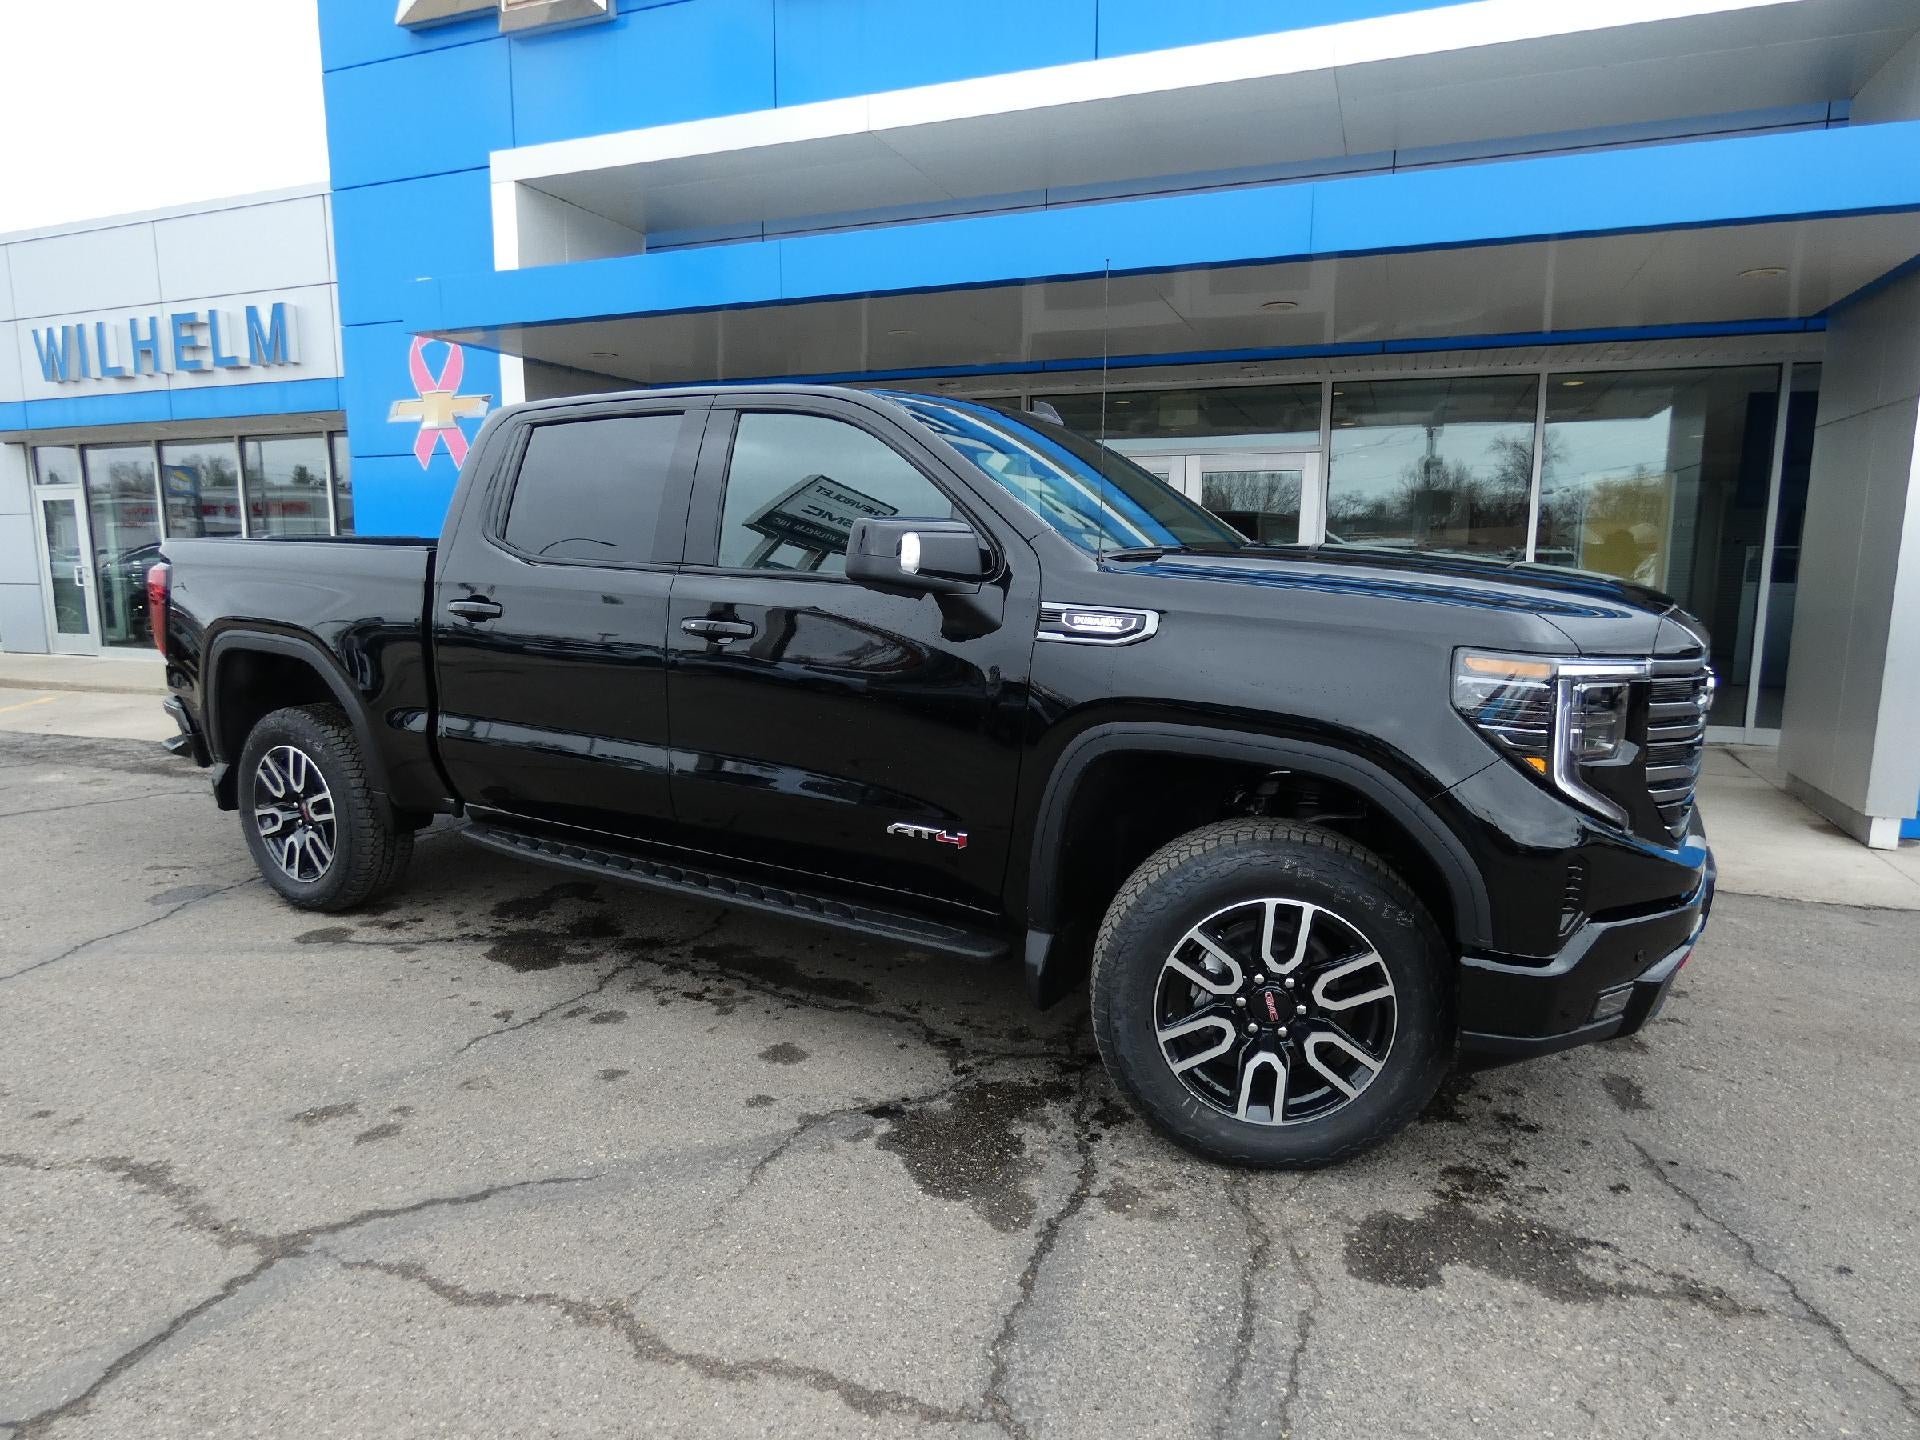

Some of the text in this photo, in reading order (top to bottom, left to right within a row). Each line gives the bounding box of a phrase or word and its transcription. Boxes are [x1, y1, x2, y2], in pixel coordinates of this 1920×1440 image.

[32, 302, 297, 383] WILHELM
[886, 822, 968, 850] AT4
[1264, 991, 1279, 1022] GMC
